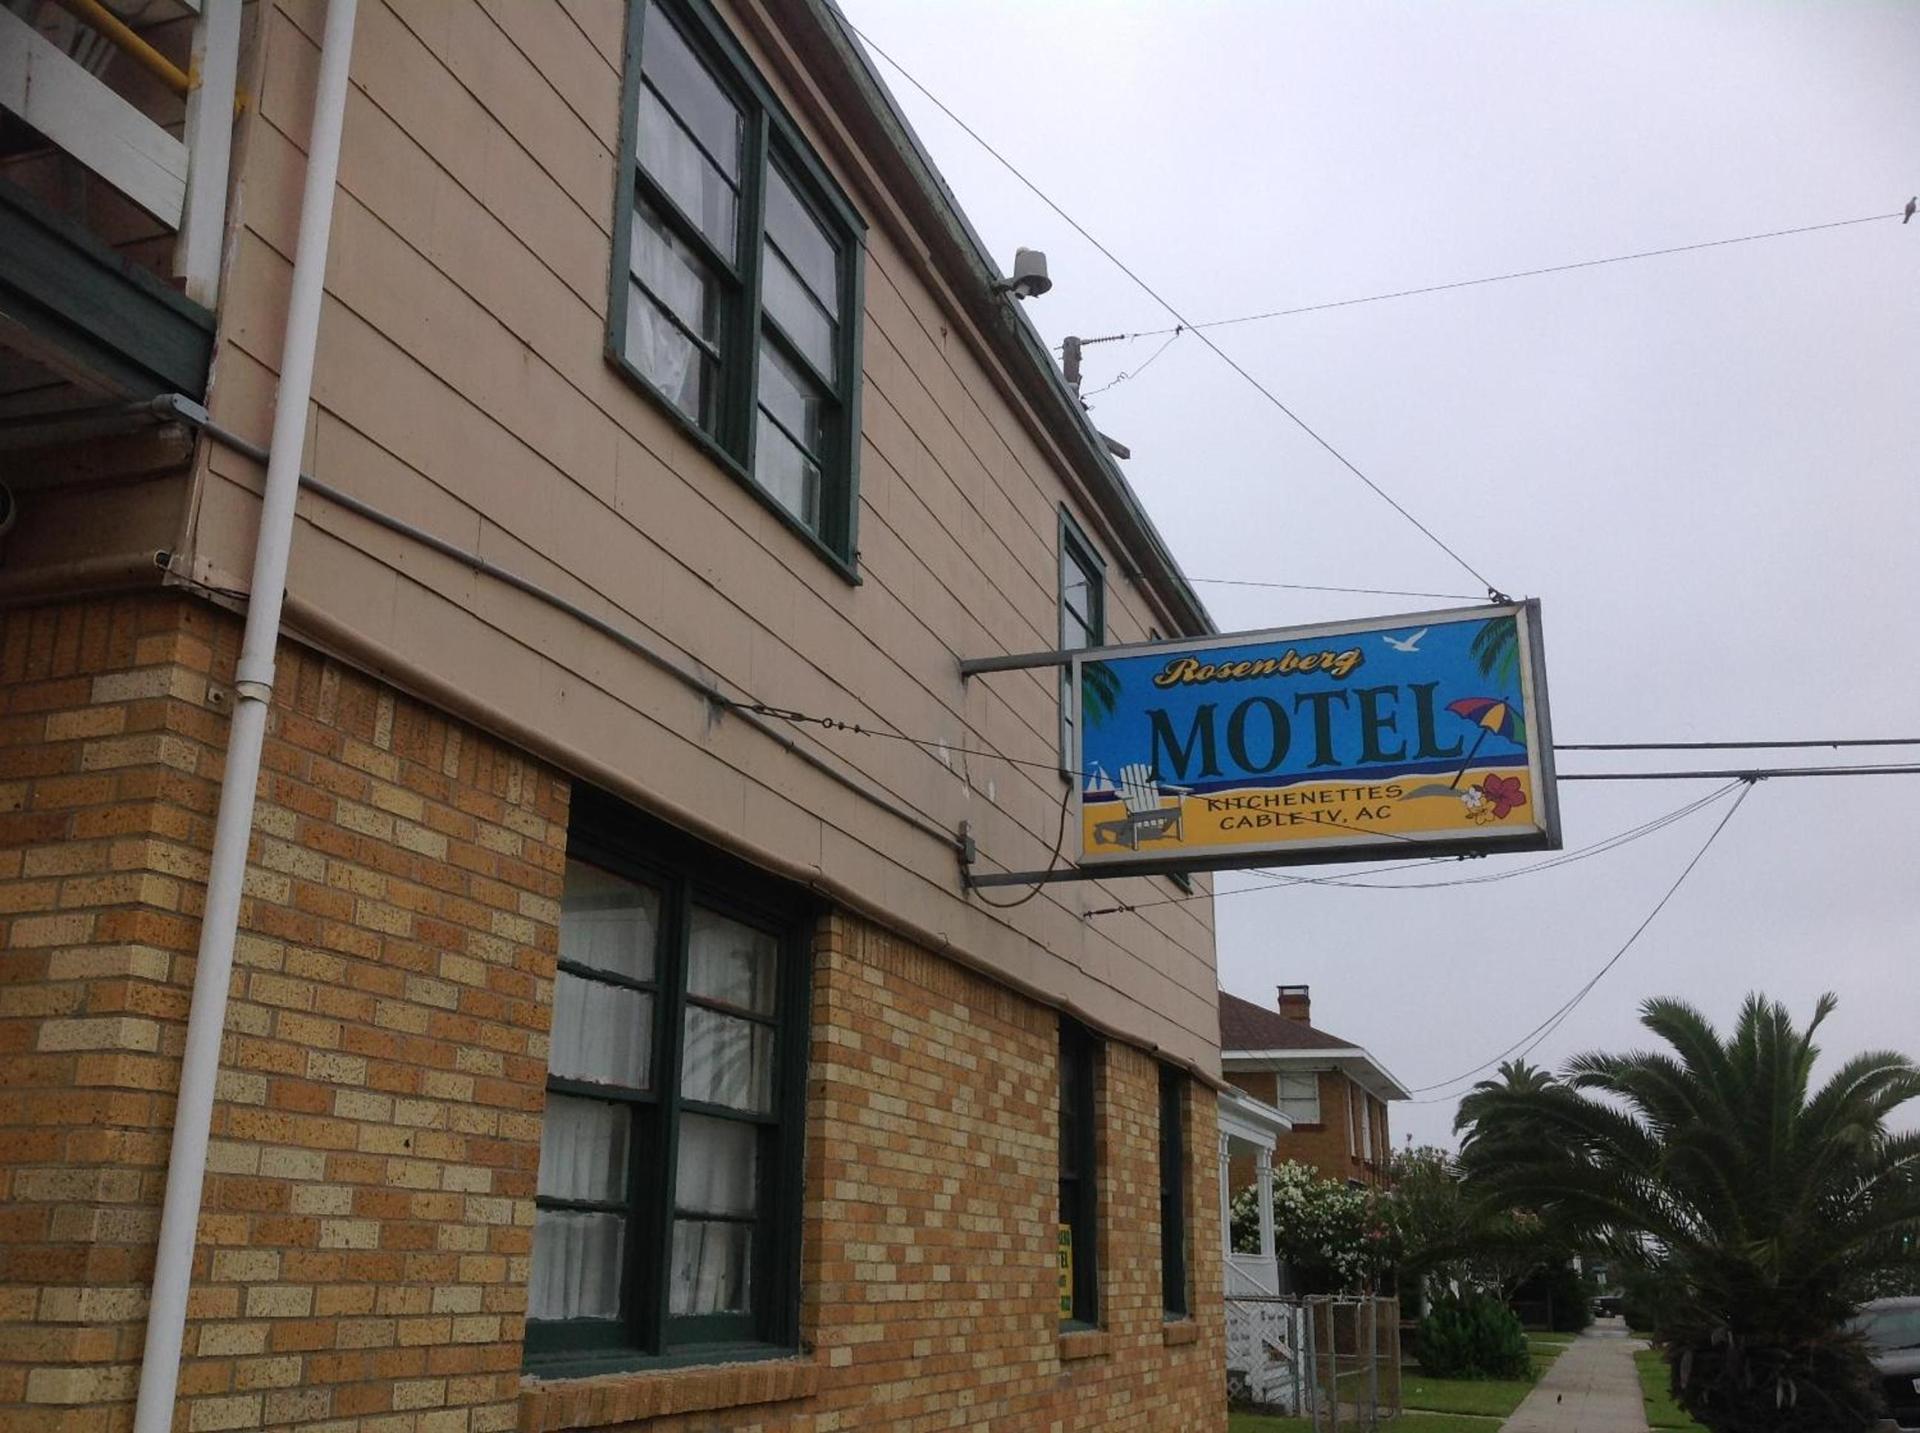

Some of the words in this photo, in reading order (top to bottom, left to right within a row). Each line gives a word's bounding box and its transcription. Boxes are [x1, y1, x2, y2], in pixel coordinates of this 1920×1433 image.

[1153, 648, 1364, 689] Rosenberg
[1145, 681, 1463, 783] MOTEL
[1207, 785, 1403, 812] KITCHENETTES
[1219, 812, 1304, 830] CABLE
[1310, 809, 1348, 824] TV,
[1355, 805, 1392, 820] AC
